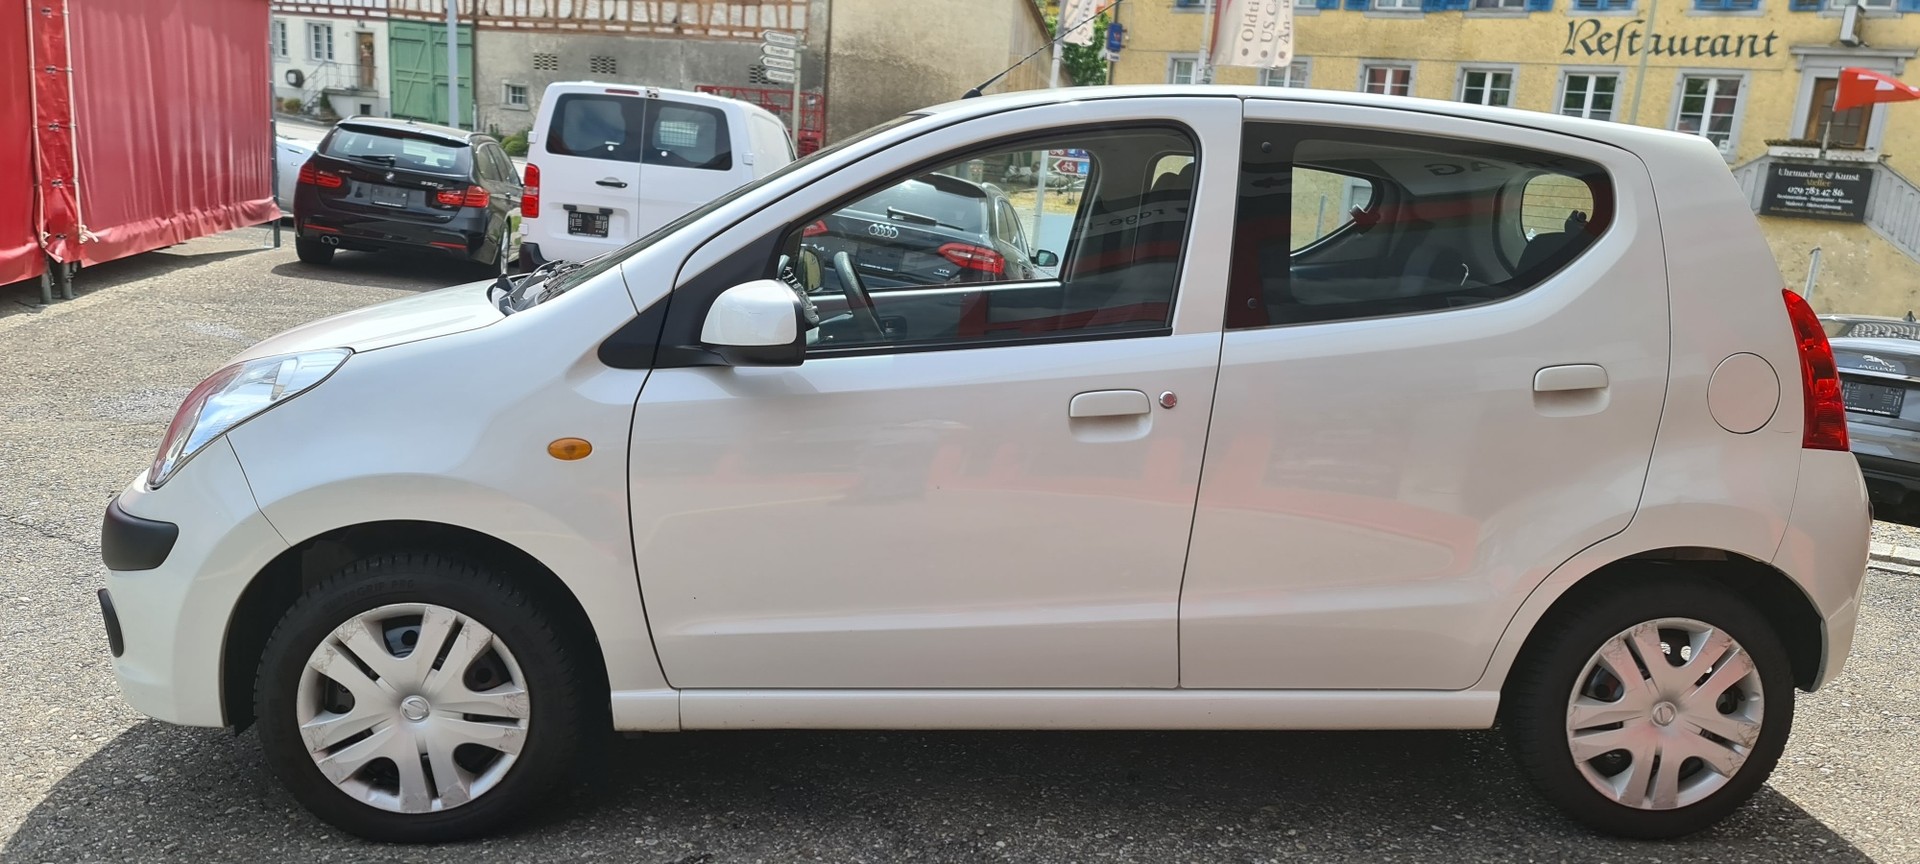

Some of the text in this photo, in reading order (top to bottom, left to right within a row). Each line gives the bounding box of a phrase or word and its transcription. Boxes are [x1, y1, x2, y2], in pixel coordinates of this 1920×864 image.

[1260, 21, 1276, 43] US
[1834, 172, 1860, 181] Kunst
[1787, 187, 1804, 195] 079
[1820, 189, 1832, 197] 47
[1858, 364, 1896, 372] JAGUAR
